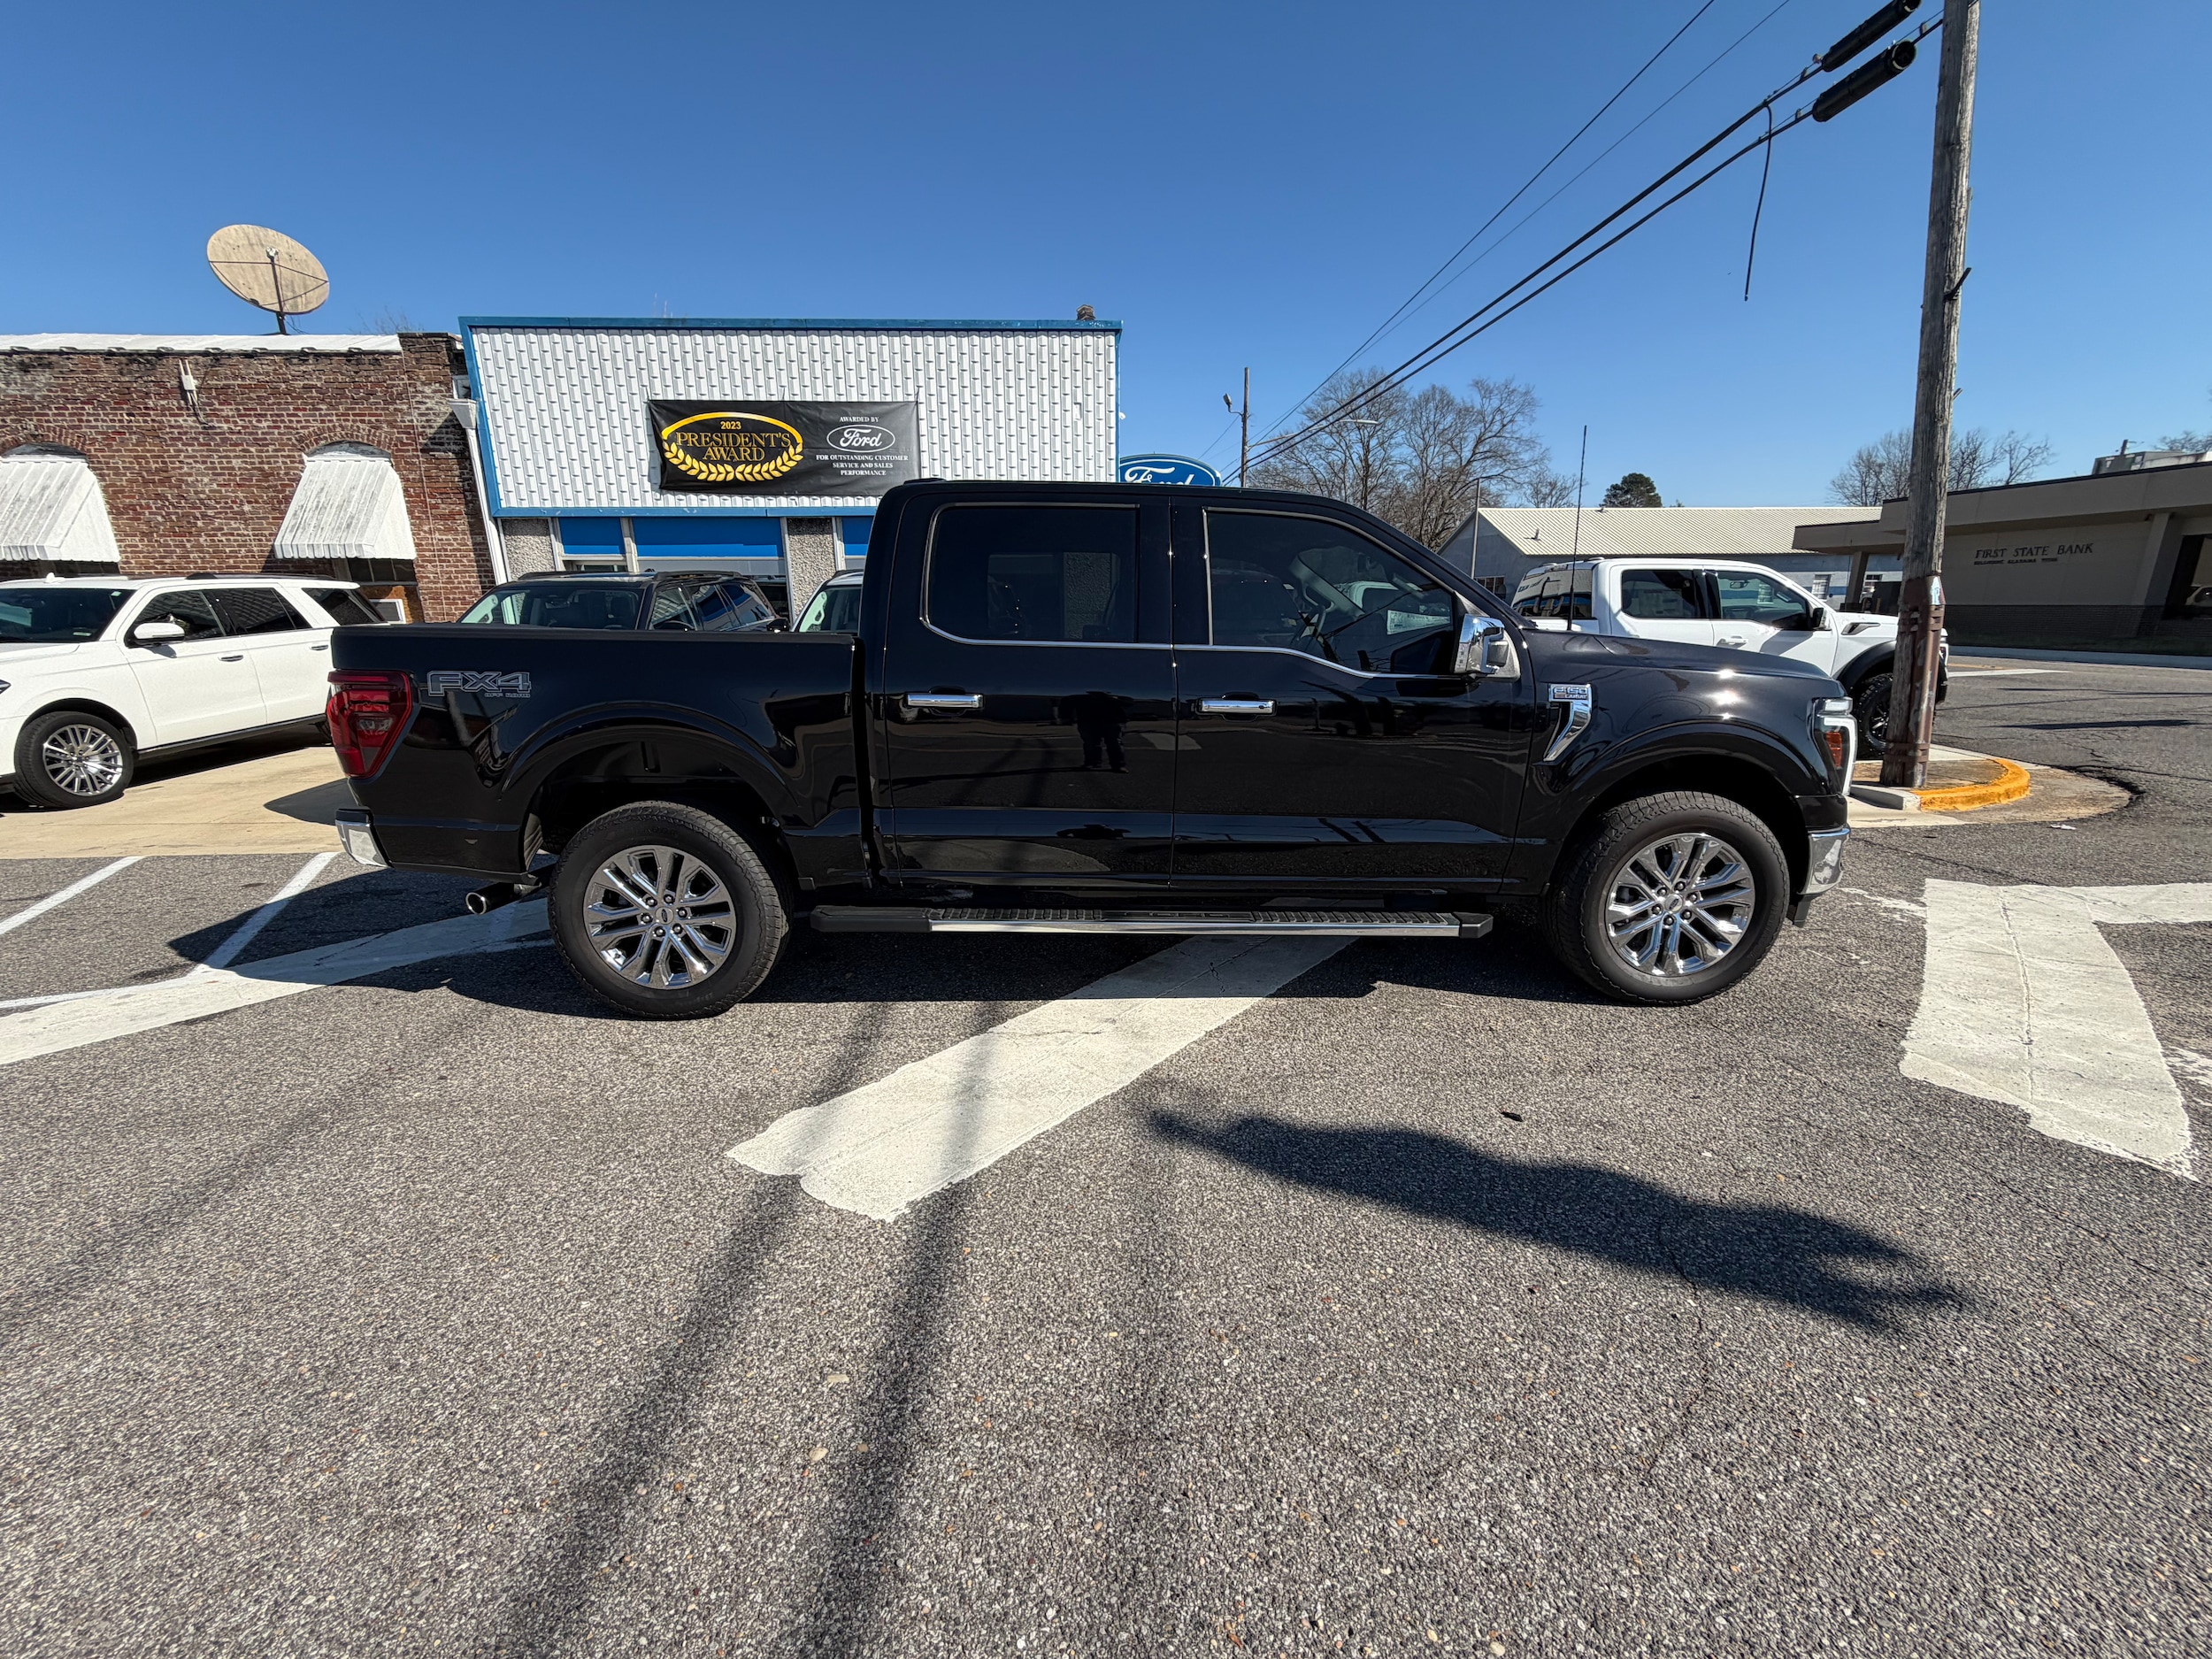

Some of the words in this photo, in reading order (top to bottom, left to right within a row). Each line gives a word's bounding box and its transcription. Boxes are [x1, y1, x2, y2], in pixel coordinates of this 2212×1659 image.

[719, 420, 742, 430] 2023
[675, 431, 791, 448] PRESIDENT'S
[839, 428, 882, 448] Ford
[702, 447, 766, 462] AWARD
[1975, 549, 2007, 558] FIRST
[2013, 547, 2049, 557] STATE
[2057, 542, 2094, 555] BANK
[426, 670, 532, 696] FX4
